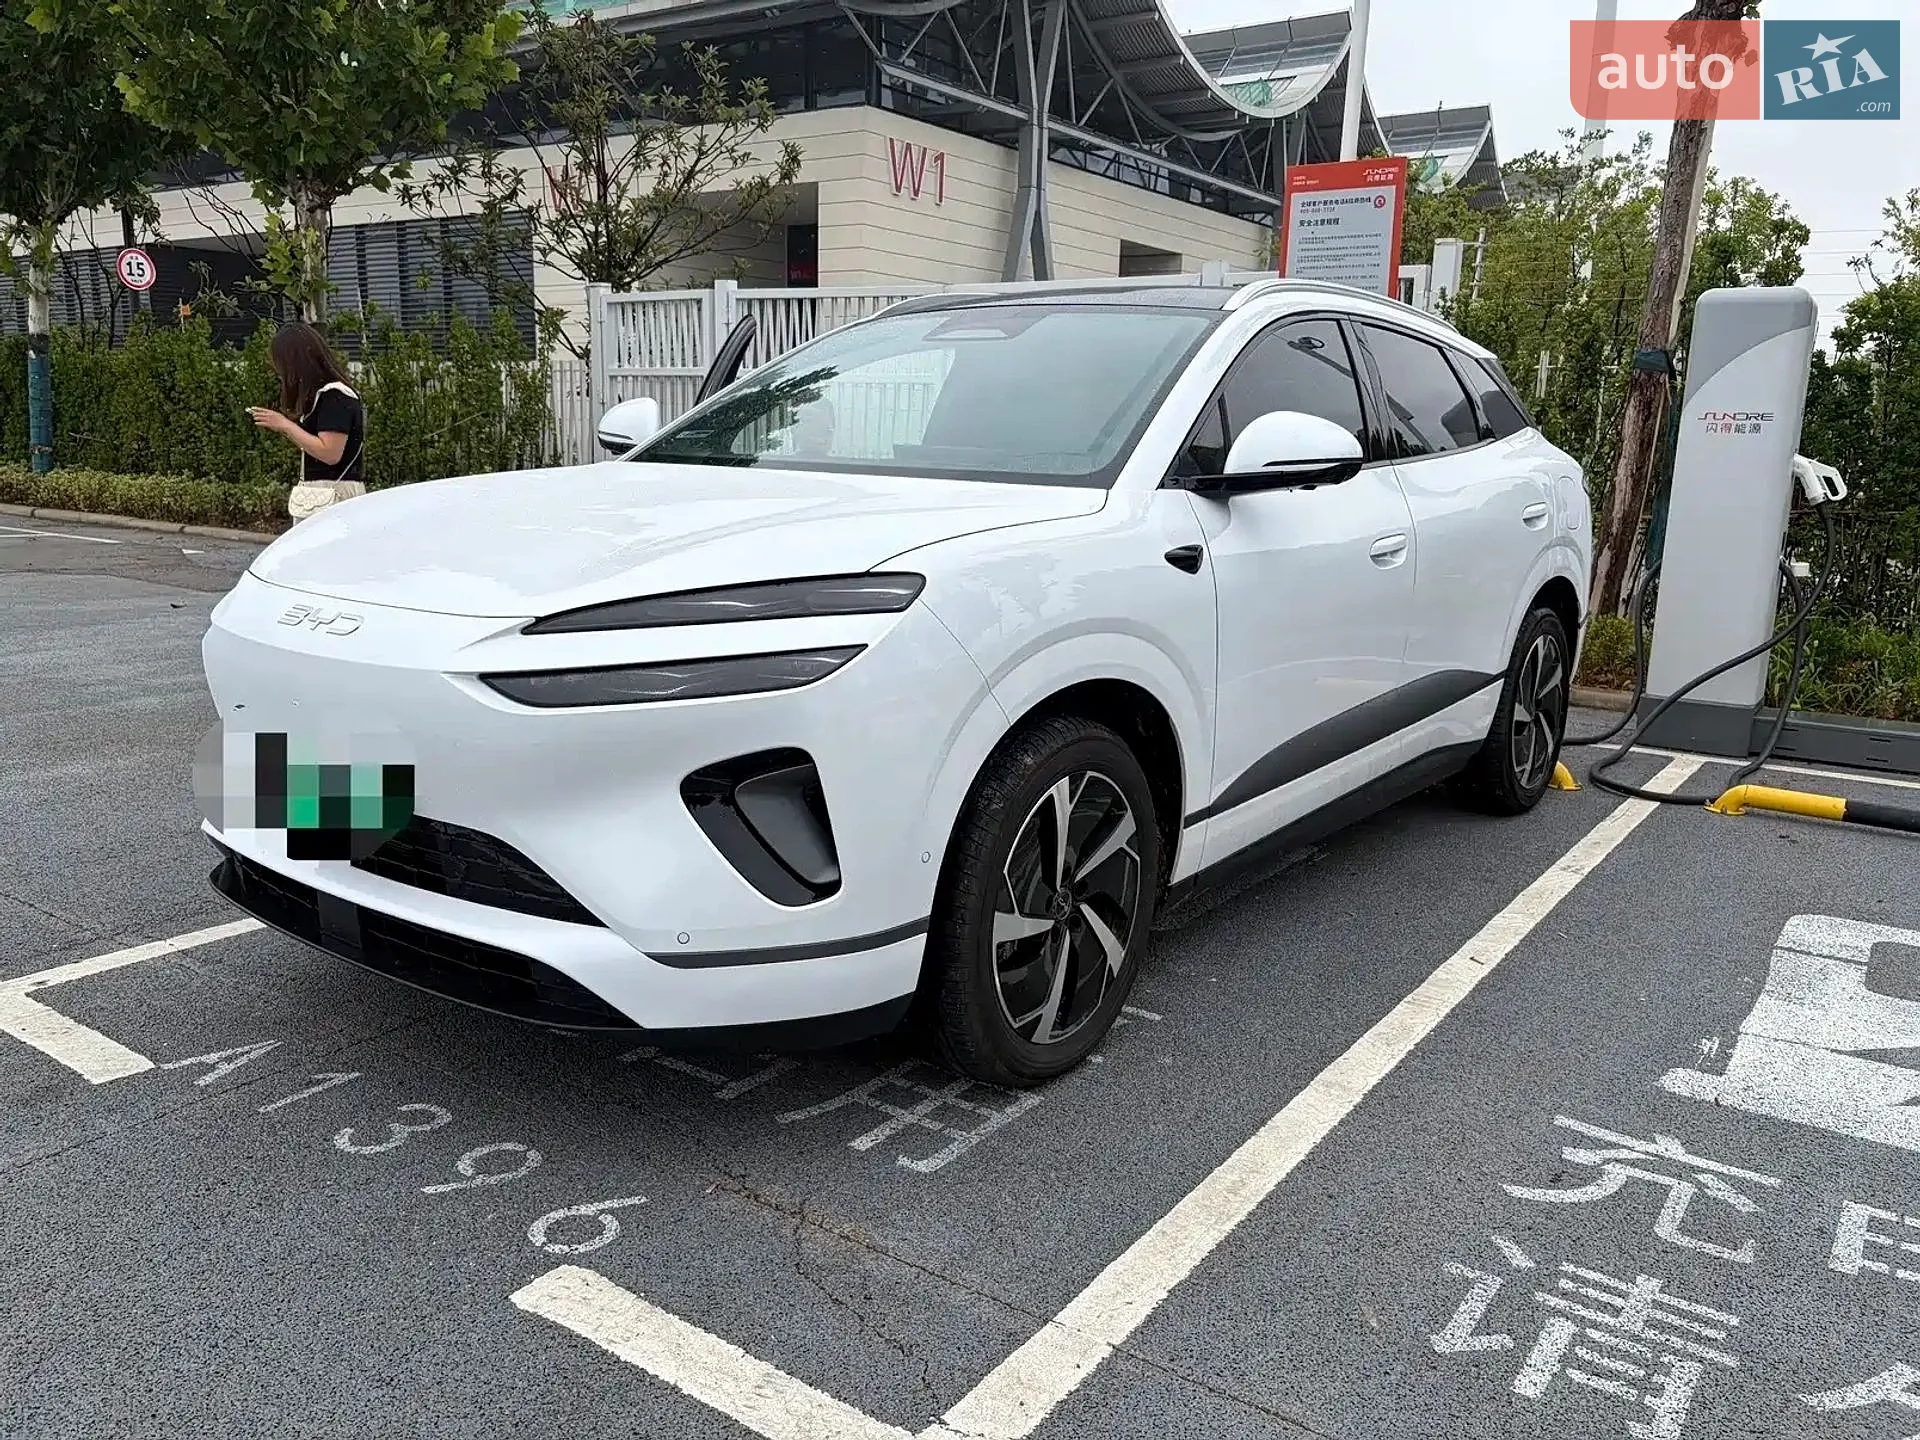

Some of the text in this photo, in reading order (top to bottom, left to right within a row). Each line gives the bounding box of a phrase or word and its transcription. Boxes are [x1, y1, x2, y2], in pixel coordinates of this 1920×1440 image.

[888, 136, 946, 206] W1
[126, 261, 146, 278] 15
[1697, 412, 1776, 422] SUNDRE
[1705, 422, 1762, 434] 闪得能源
[277, 603, 366, 636] BYD
[158, 1039, 648, 1255] A1396
